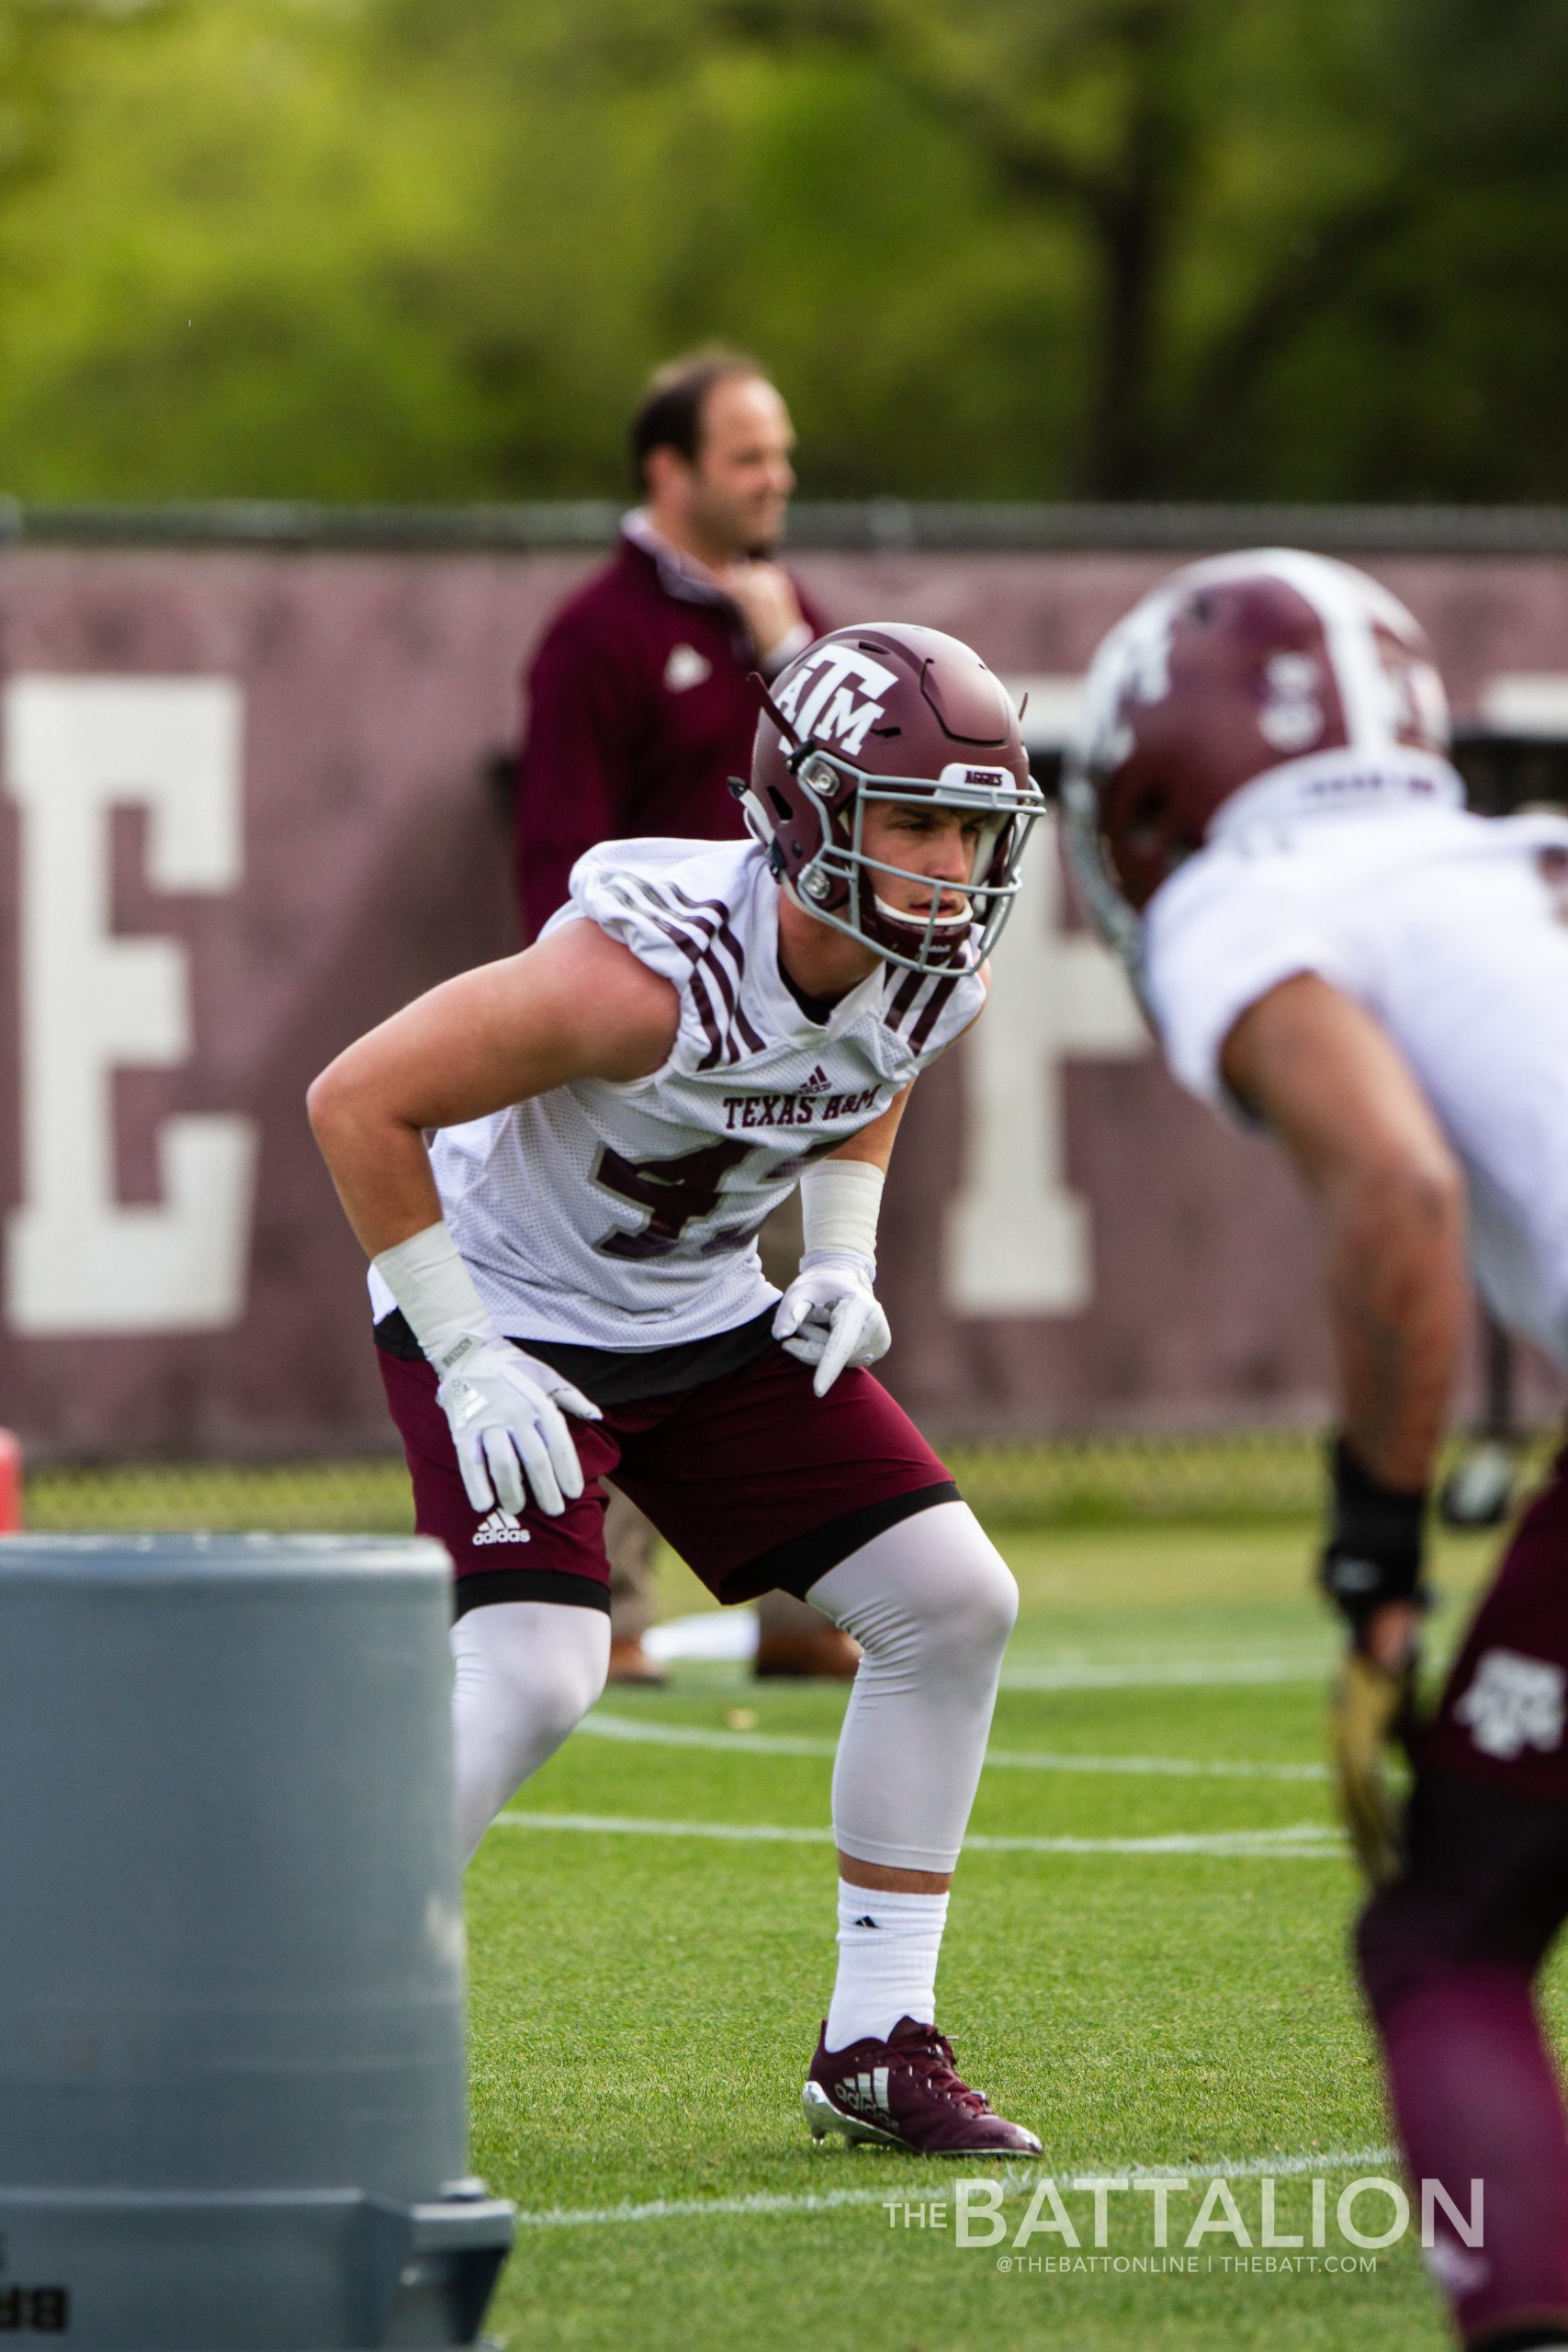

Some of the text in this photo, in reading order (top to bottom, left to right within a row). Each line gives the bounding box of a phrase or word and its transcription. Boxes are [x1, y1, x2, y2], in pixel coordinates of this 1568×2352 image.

[964, 770, 1003, 787] AGGIES
[8, 679, 256, 1333] E
[723, 1083, 883, 1129] TEXAS A&M
[472, 1528, 531, 1545] adidas
[833, 2083, 900, 2132] adidas
